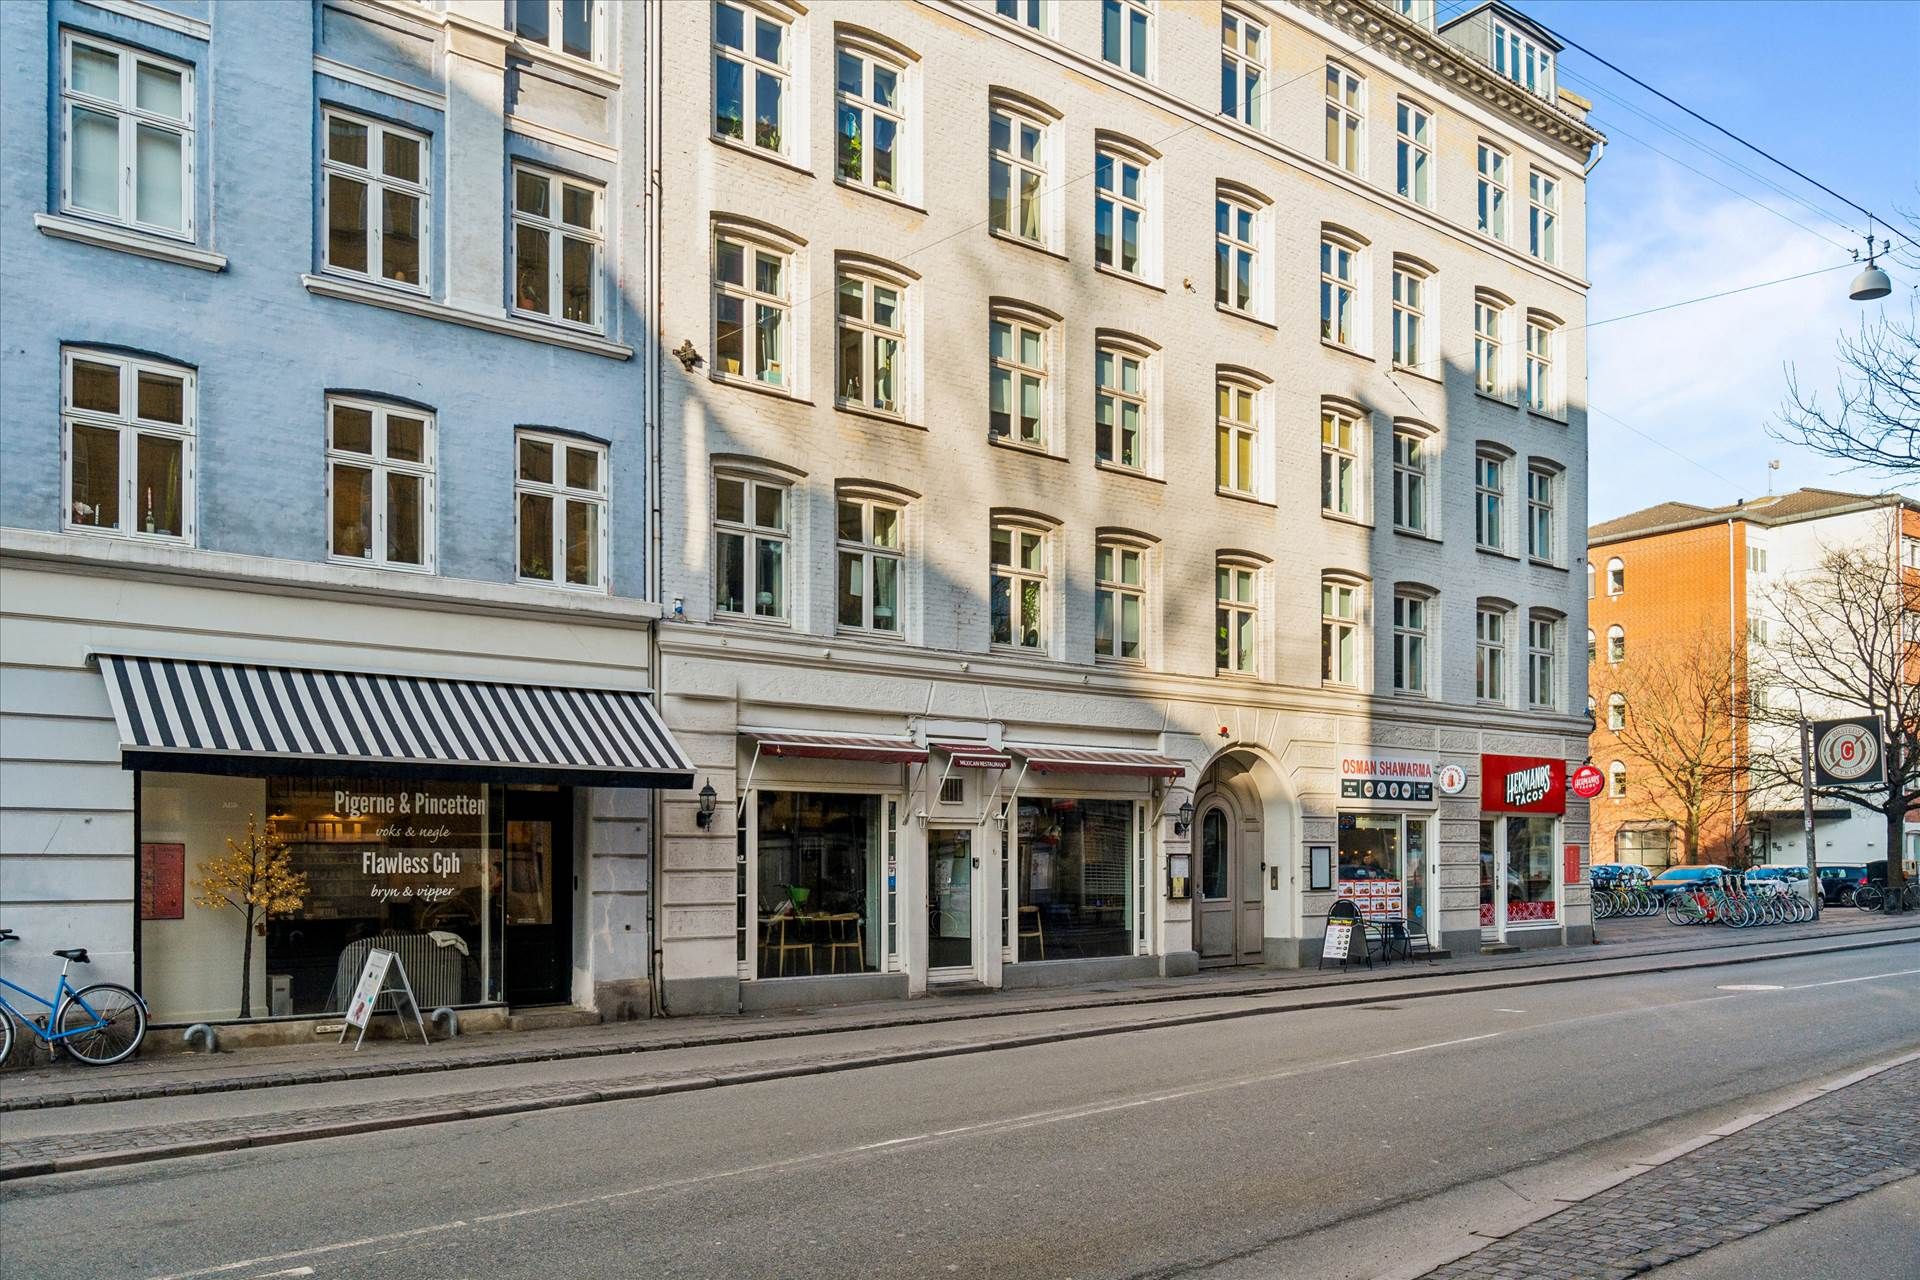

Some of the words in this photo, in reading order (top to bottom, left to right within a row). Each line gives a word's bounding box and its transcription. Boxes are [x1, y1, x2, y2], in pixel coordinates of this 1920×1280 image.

[1342, 758, 1377, 775] OSMAN
[1379, 760, 1432, 778] SHAWARMA
[1507, 764, 1550, 803] HERMANOS
[1574, 774, 1600, 789] HERMANOS
[334, 790, 395, 817] Pigerne
[399, 792, 411, 814] &
[415, 792, 486, 815] Pincetten
[1515, 789, 1544, 806] TACOS
[375, 824, 401, 838] voks
[404, 827, 416, 838] &
[419, 824, 451, 843] negle
[362, 851, 429, 875] Flawless
[433, 851, 460, 878] Cph
[371, 884, 401, 903] bryn
[402, 886, 414, 897] &
[416, 884, 455, 902] vipper
